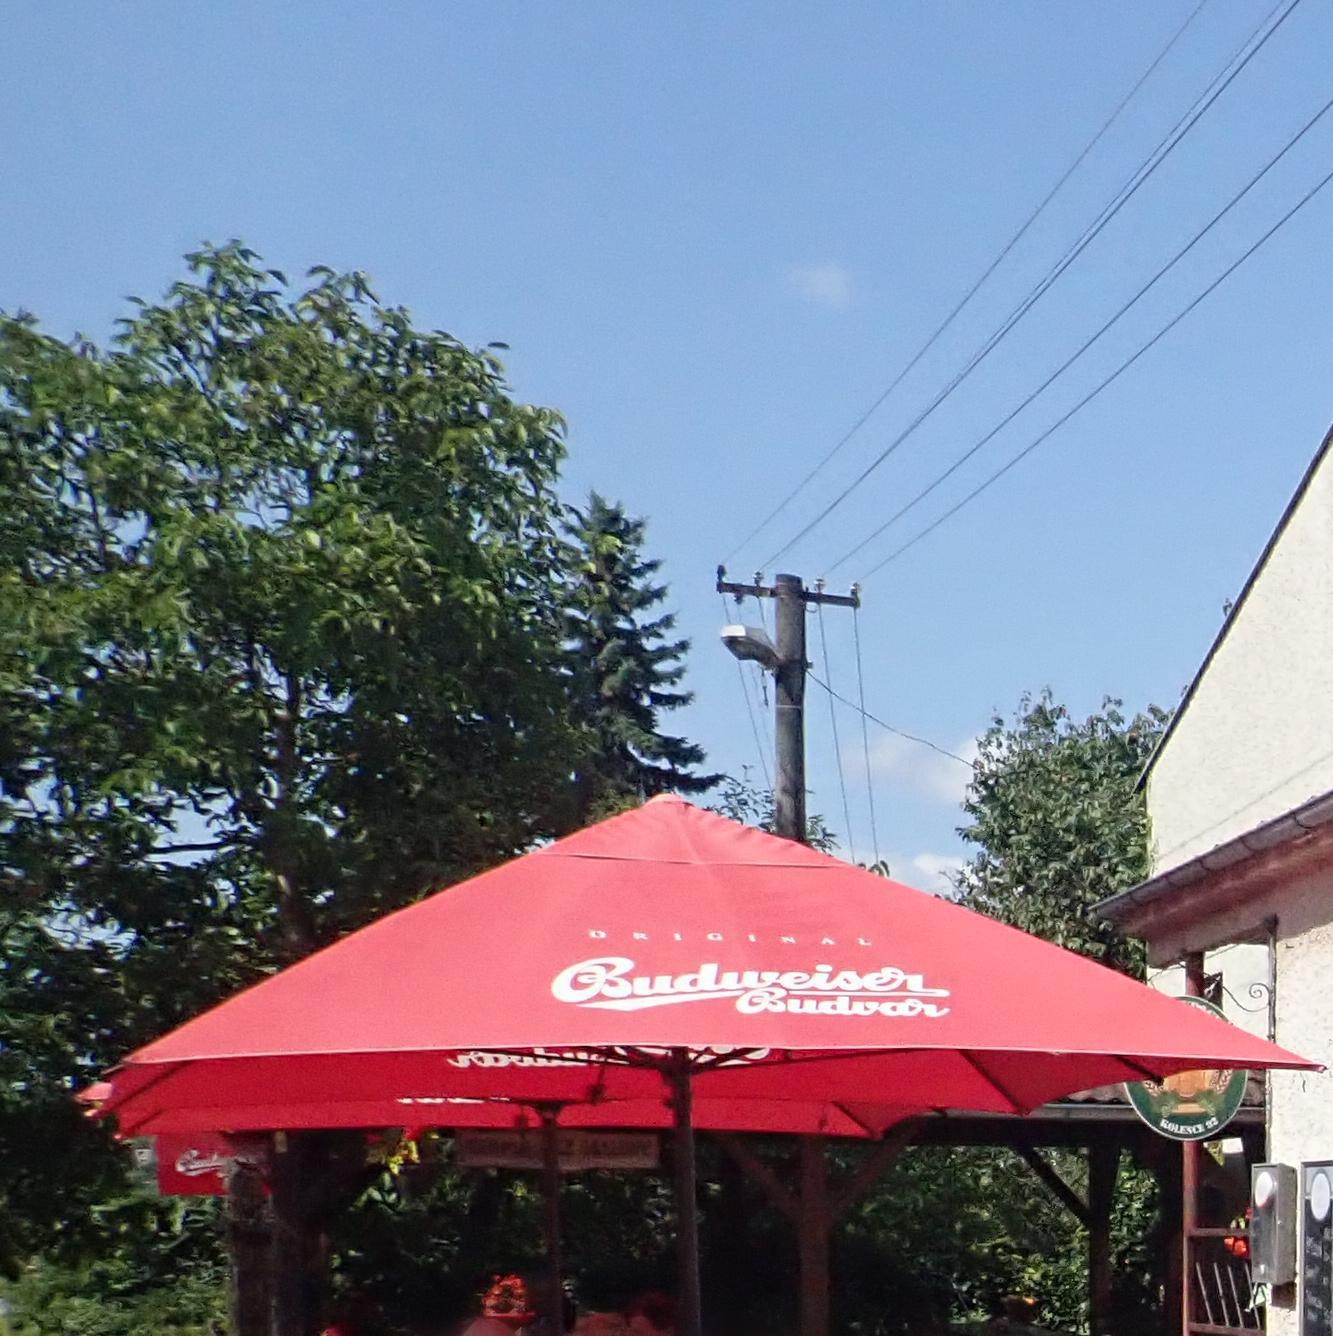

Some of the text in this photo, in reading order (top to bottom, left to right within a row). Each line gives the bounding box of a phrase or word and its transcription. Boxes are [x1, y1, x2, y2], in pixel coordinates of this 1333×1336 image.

[588, 929, 873, 947] ORIGINAL
[551, 956, 950, 1007] Budweiser
[736, 987, 950, 1018] Budvar
